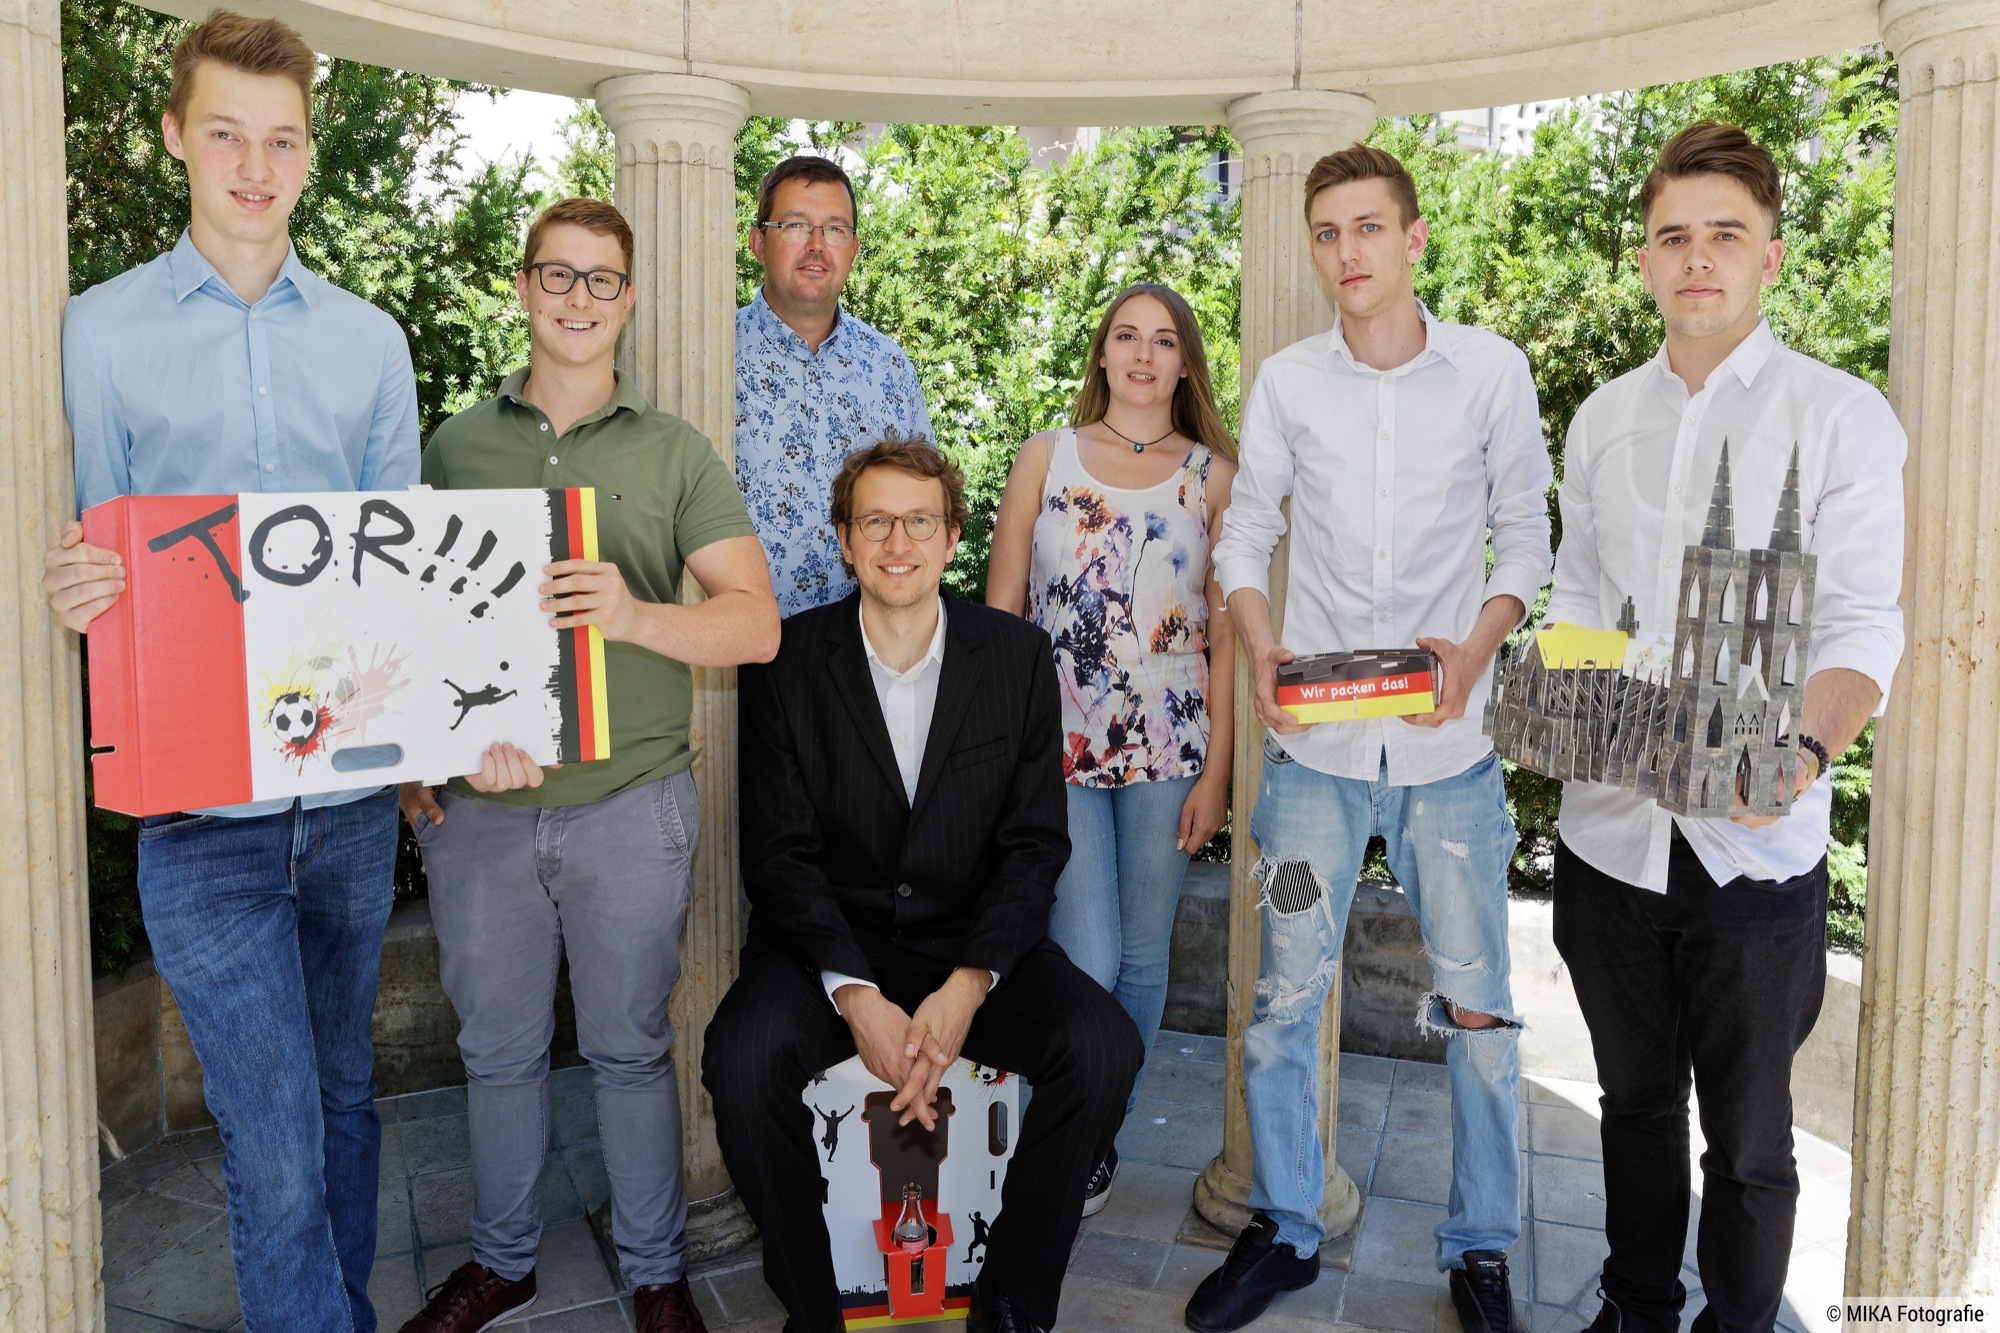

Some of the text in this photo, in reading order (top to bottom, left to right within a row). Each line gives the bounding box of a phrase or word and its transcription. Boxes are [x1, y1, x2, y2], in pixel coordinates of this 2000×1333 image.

[1300, 677, 1409, 699] Wir packen das!
